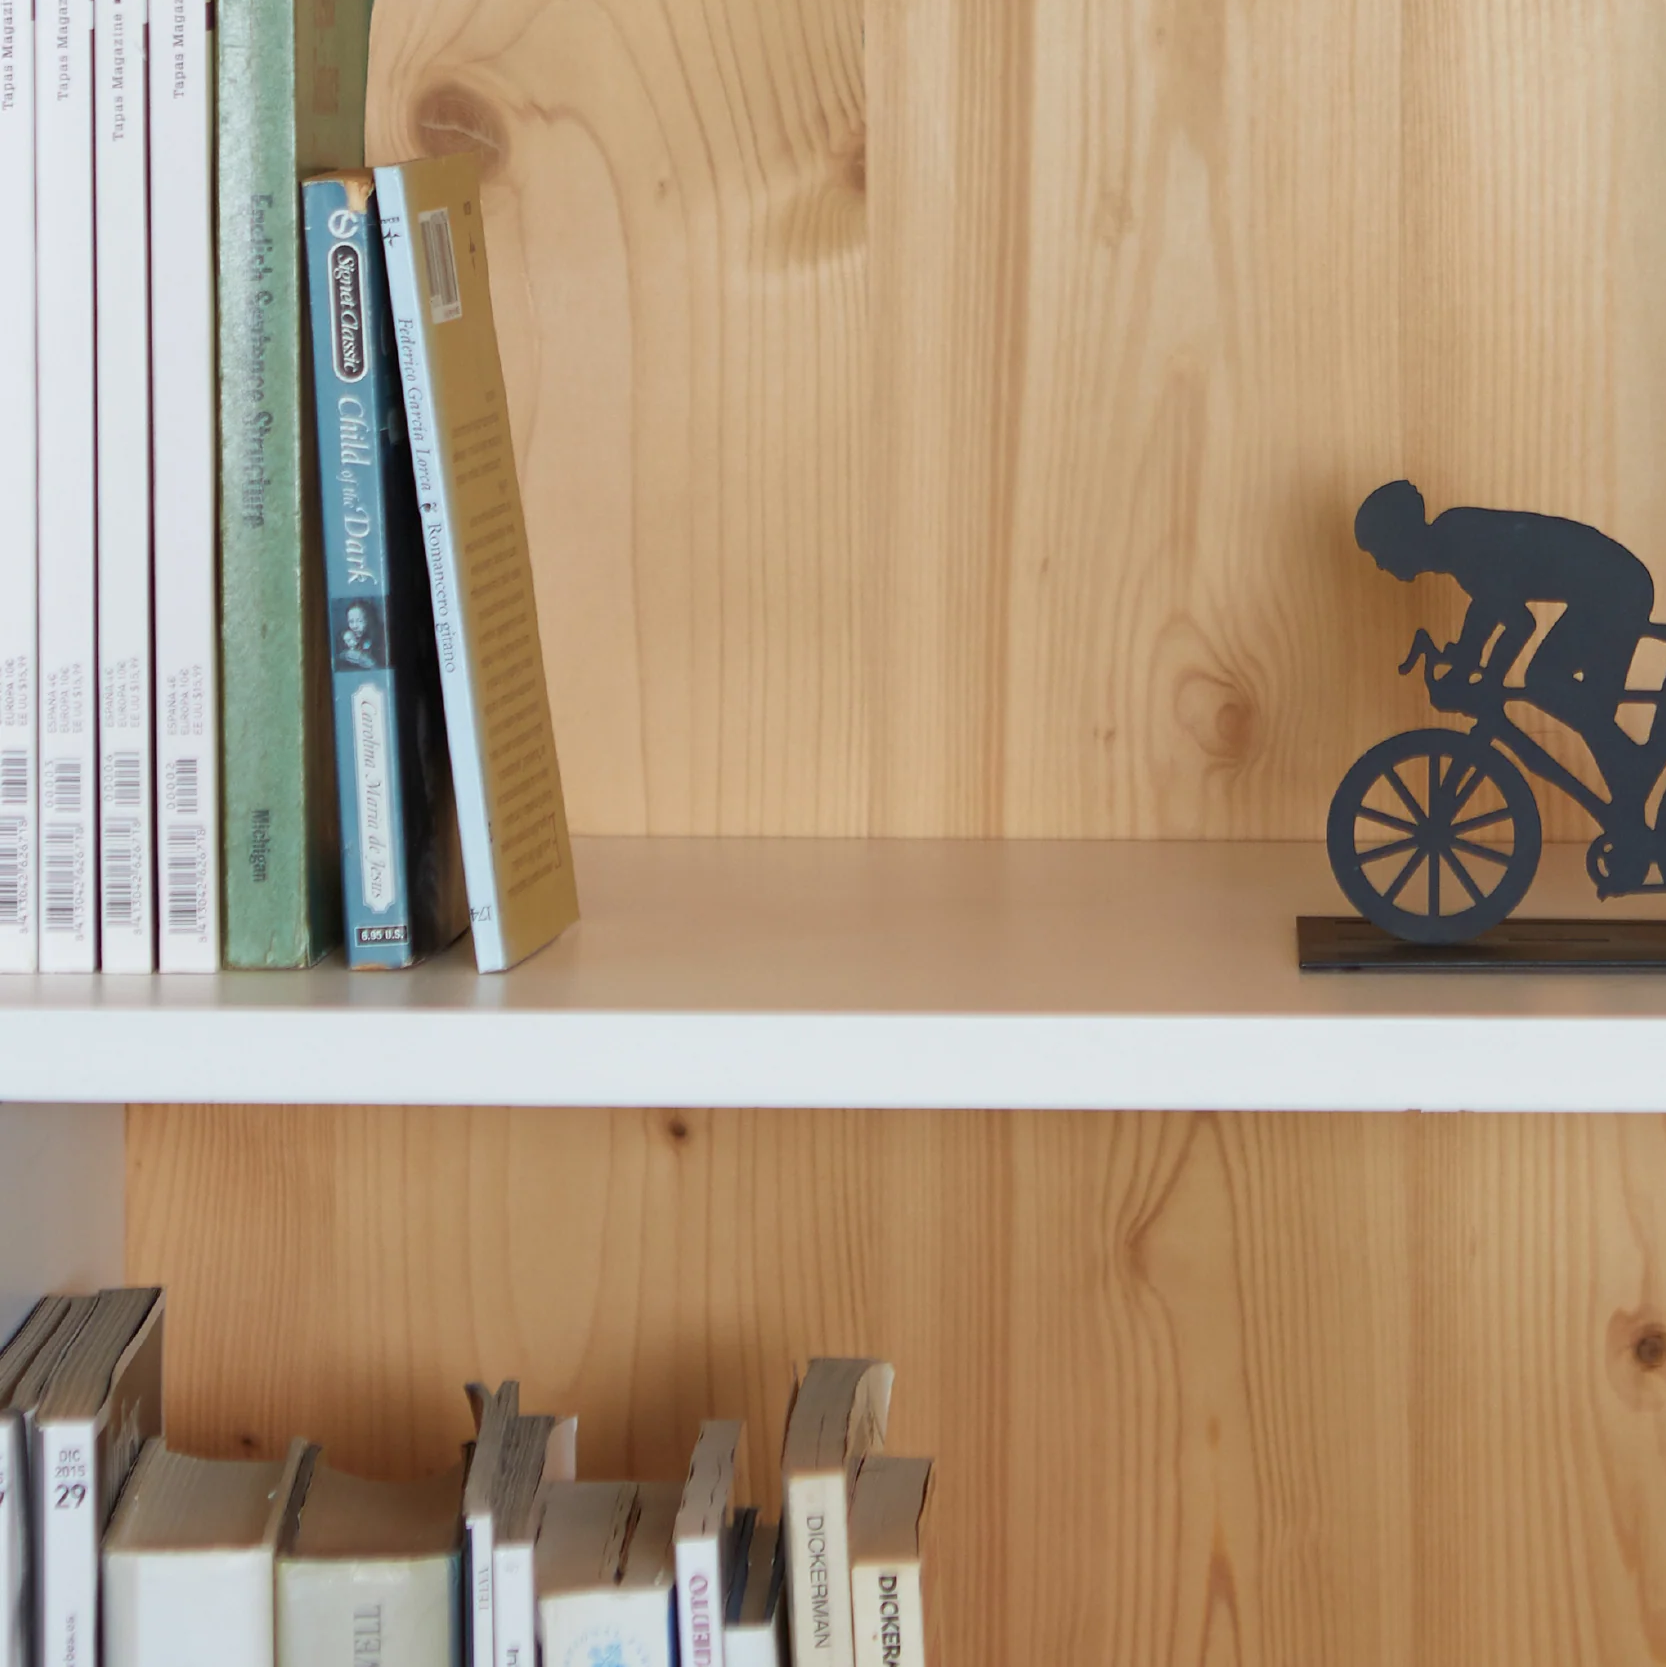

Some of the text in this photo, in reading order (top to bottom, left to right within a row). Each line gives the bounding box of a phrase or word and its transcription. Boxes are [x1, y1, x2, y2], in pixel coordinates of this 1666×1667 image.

[57, 54, 69, 101] Tapas
[111, 12, 125, 89] Magazine
[172, 53, 185, 99] Tapas
[112, 95, 125, 141] Tapas
[333, 254, 360, 373] Signet Classic
[335, 395, 377, 586] Child of Dark
[397, 316, 457, 674] Federico García Lorca Romancero gitano
[360, 699, 386, 899] Carolina Maria de Jesus
[249, 809, 270, 883] Michigan
[361, 929, 383, 941] 6.95
[55, 1465, 85, 1478] 2015
[59, 1450, 80, 1462] DIC
[55, 1483, 88, 1509] 29
[806, 1515, 830, 1649] DICKERMAN
